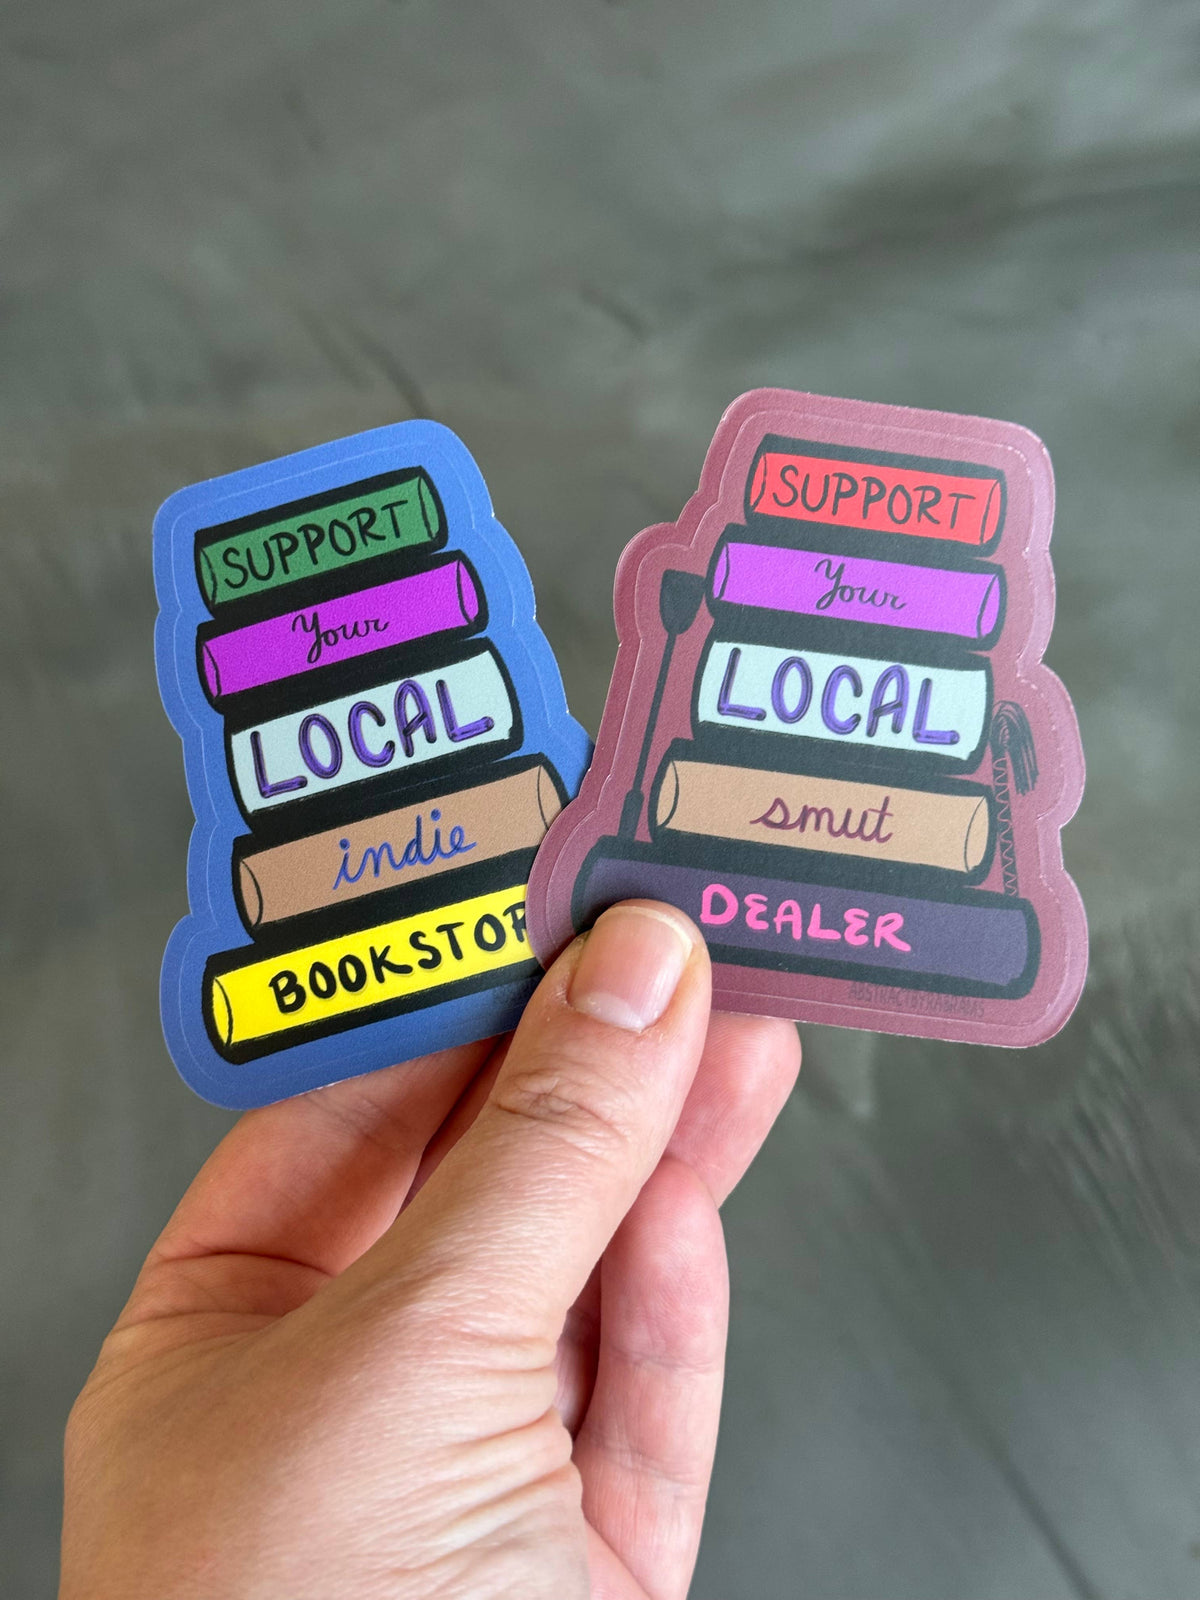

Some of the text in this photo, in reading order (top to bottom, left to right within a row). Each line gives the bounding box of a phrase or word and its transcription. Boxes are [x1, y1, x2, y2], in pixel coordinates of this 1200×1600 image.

[772, 465, 976, 529] SUPPORT
[222, 500, 409, 589] SUPPORT
[814, 558, 907, 610] Your
[291, 614, 389, 664] Your
[717, 647, 961, 746] LOCAL
[250, 678, 495, 798] LOCAL
[332, 808, 477, 890] indie
[749, 796, 893, 843] smut
[700, 883, 911, 951] DEALER
